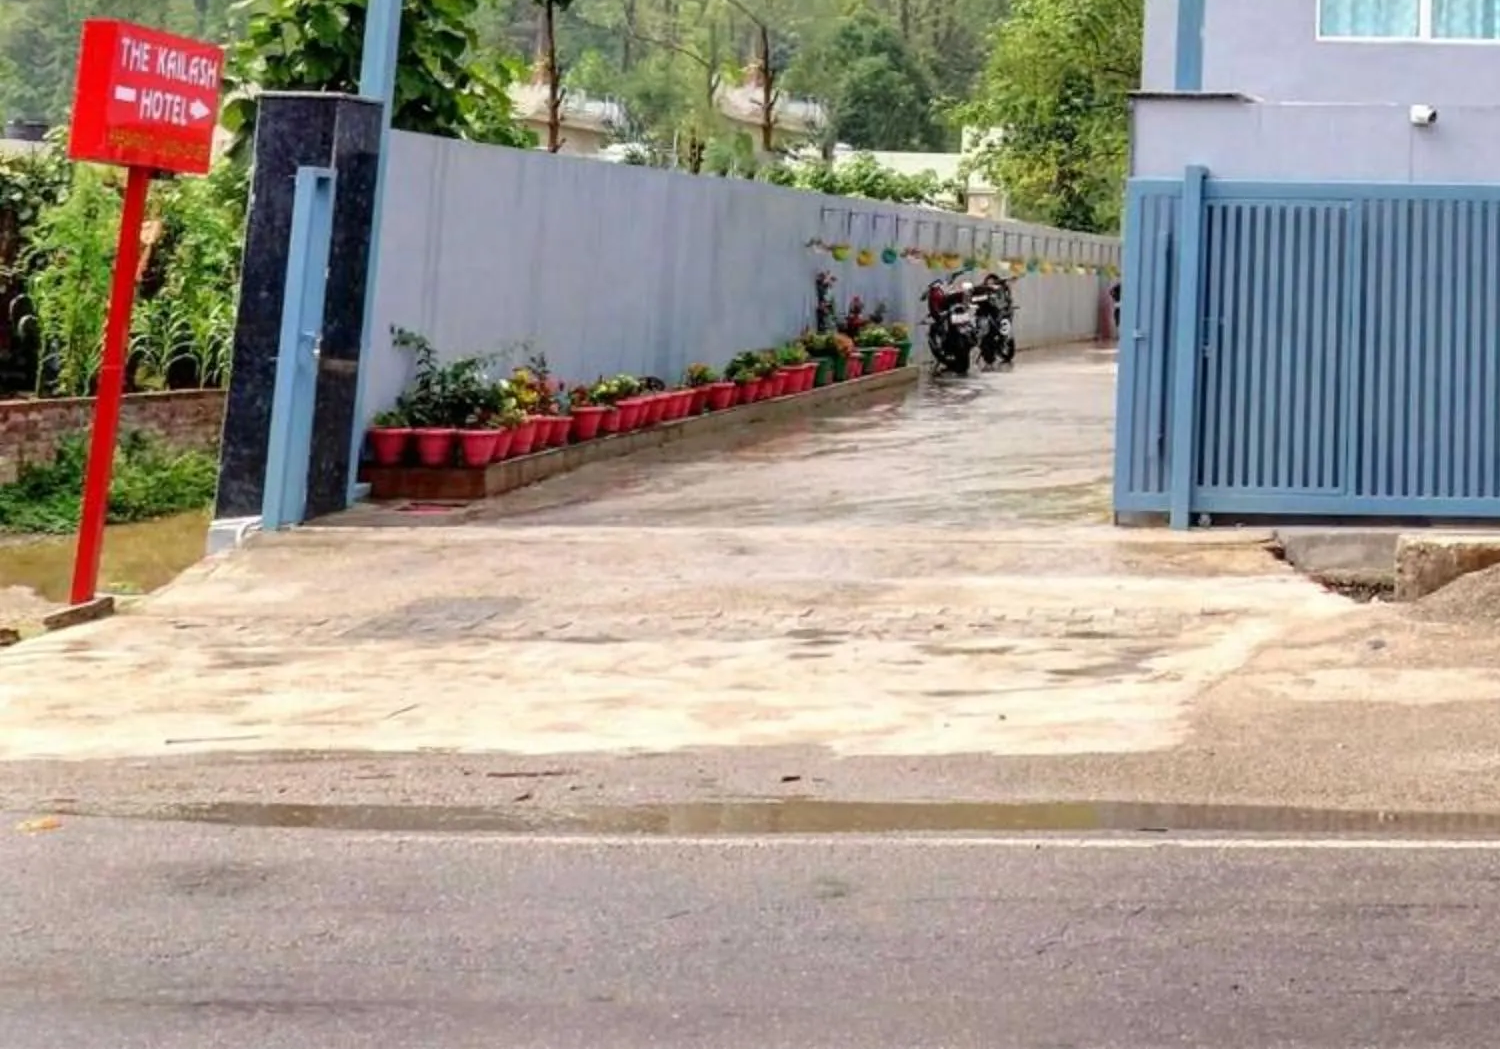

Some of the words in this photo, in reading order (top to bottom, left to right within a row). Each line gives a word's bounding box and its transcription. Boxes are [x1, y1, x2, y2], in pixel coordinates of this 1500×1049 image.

[121, 36, 151, 72] THE
[156, 46, 218, 90] KAILASH
[139, 87, 188, 127] HOTEL
